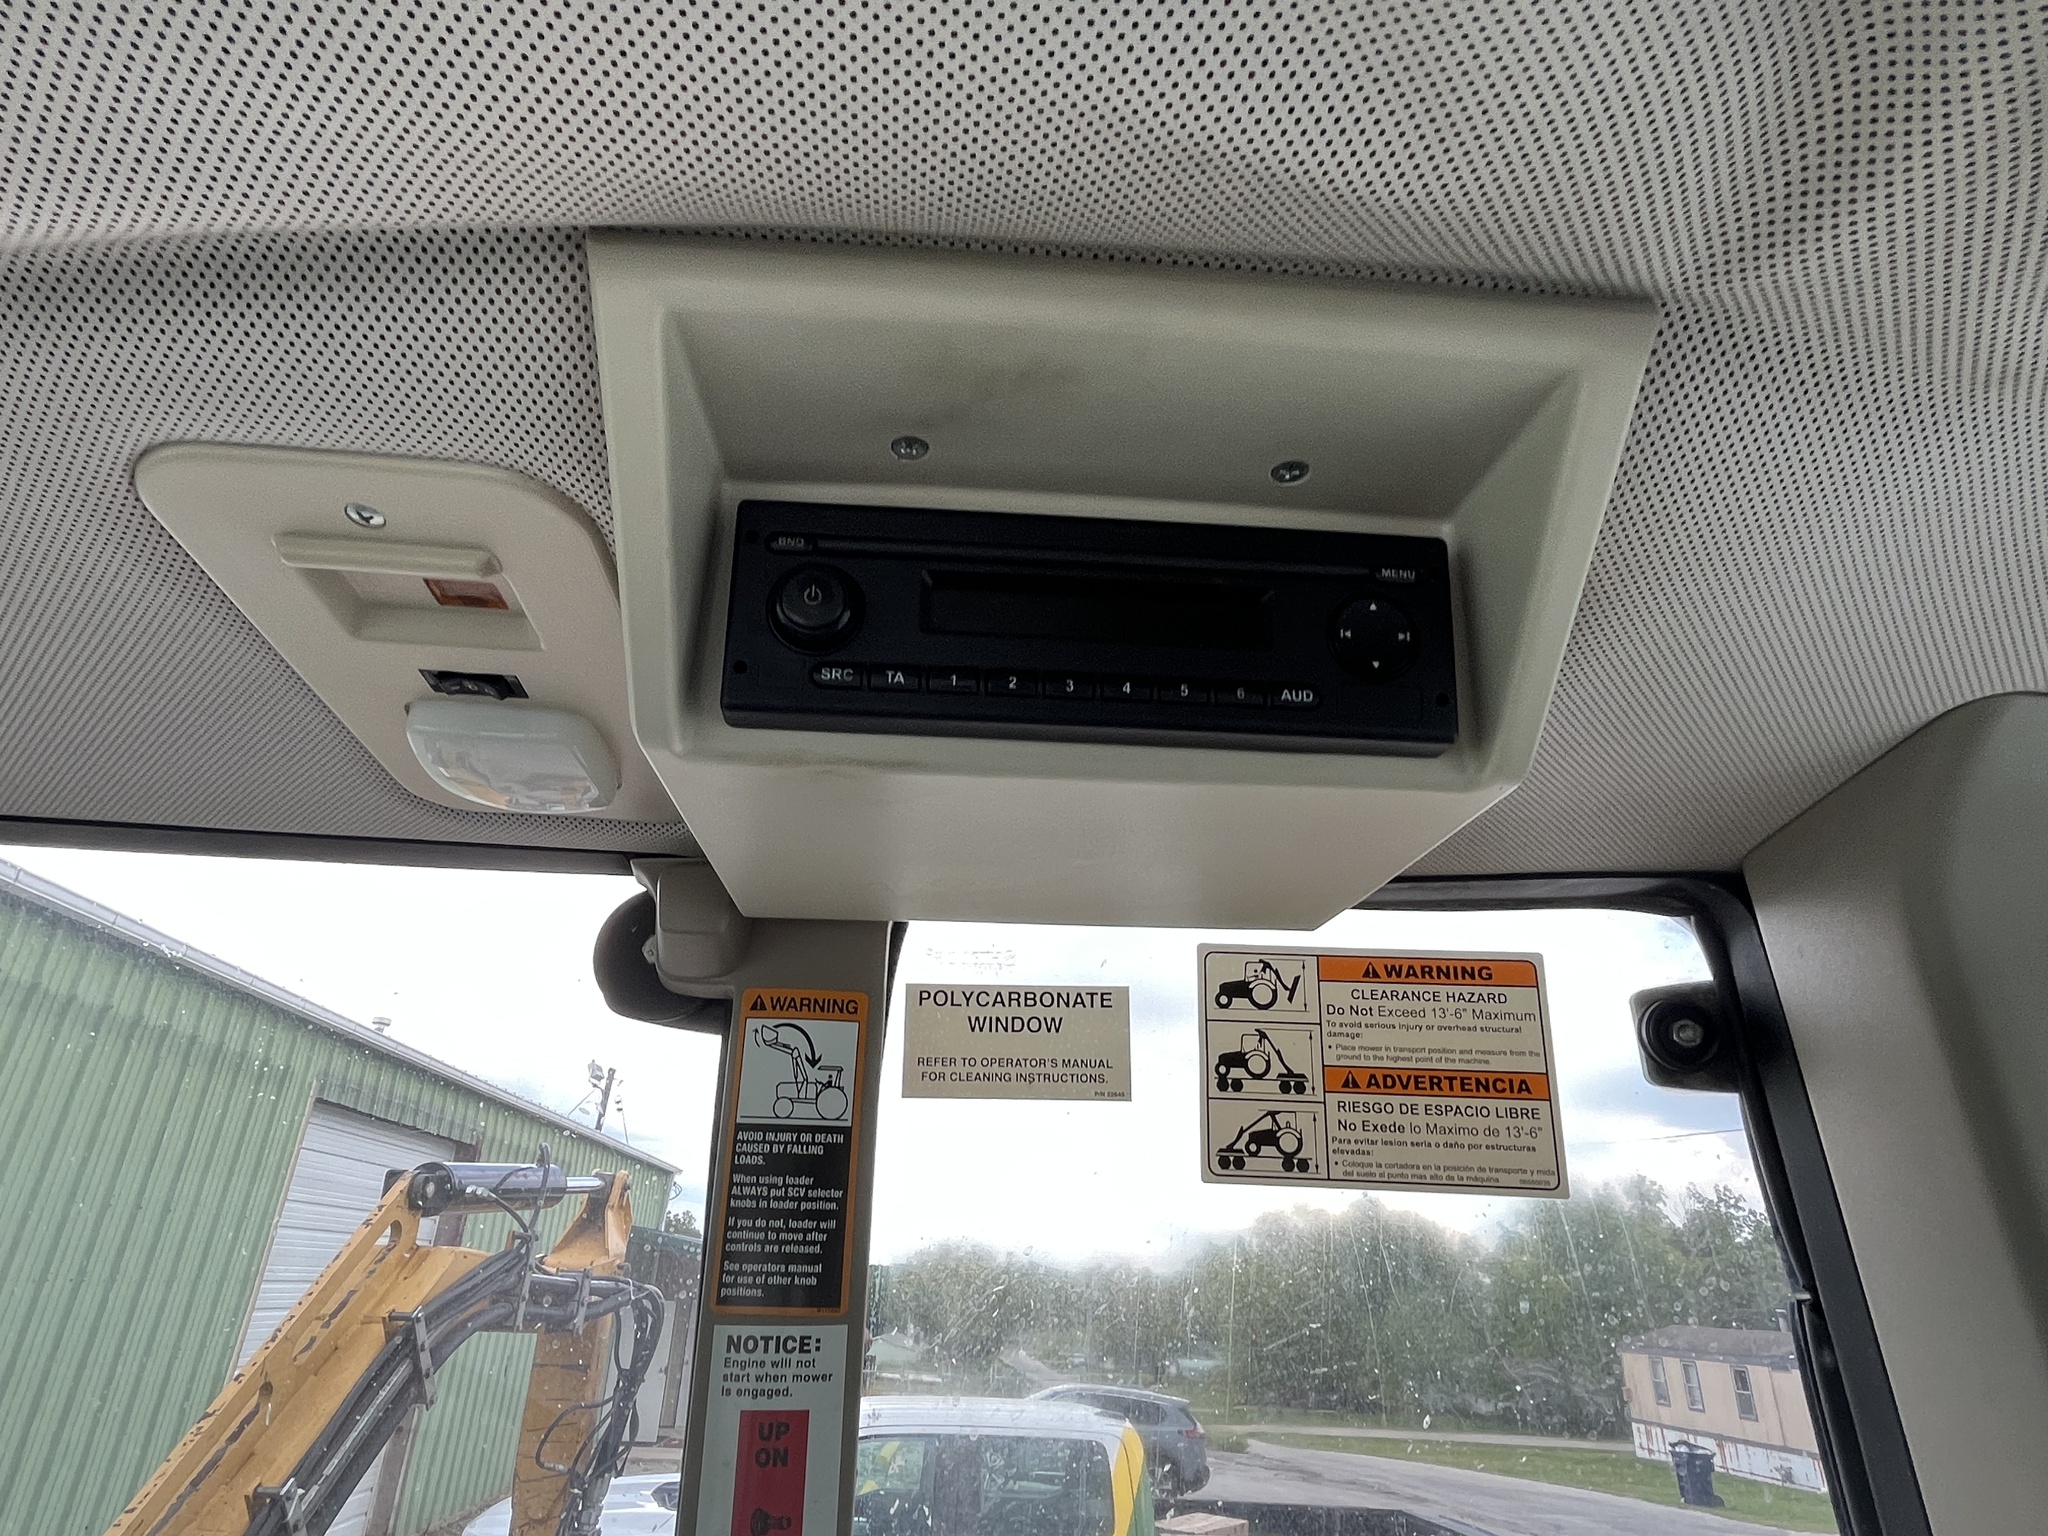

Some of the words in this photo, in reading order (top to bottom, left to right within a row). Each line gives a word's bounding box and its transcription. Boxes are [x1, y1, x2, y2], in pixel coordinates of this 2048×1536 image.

[778, 535, 805, 547] BND
[1381, 568, 1415, 580] MENU
[821, 667, 854, 681] SRC
[886, 670, 905, 685] TA
[951, 674, 957, 686] 1
[1008, 676, 1017, 690] 2
[1066, 679, 1074, 692] 3
[1122, 682, 1131, 694] 4
[1180, 684, 1189, 697] 5
[1236, 687, 1245, 700] 6
[1281, 689, 1314, 703] AUD
[1384, 964, 1493, 981] WARNING
[919, 990, 1113, 1009] POLYCARBONATE
[1351, 989, 1441, 1003] CLEARANCE
[1446, 991, 1508, 1004] HAZARD
[770, 996, 859, 1015] WARNING
[1326, 1004, 1345, 1016] Do
[1350, 1004, 1374, 1017] Not
[1378, 1006, 1426, 1019] Exceed
[1432, 1007, 1468, 1020] 13'-6"
[1472, 1008, 1536, 1022] Maximum
[968, 1016, 1063, 1033] WINDOW
[1398, 1023, 1422, 1032] injury
[1437, 1024, 1477, 1032] overhead
[1393, 1046, 1426, 1054] transport
[1428, 1047, 1456, 1055] position
[918, 1057, 957, 1067] REFER
[961, 1057, 977, 1068] TO
[980, 1057, 1058, 1068] OPERATOR'S
[1062, 1058, 1113, 1069] MANUAL
[1386, 1055, 1413, 1064] highest
[1415, 1056, 1433, 1064] point
[921, 1072, 946, 1082] FOR
[950, 1072, 1011, 1083] CLEANING
[1016, 1073, 1108, 1084] INSTRUCTIONS.
[1366, 1073, 1533, 1095] ADVERTENCIA
[1337, 1101, 1394, 1114] RIESGO
[1400, 1103, 1419, 1115] DE
[1425, 1104, 1491, 1118] ESPACIO
[1496, 1107, 1541, 1120] LIBRE
[1338, 1119, 1357, 1132] No
[1362, 1120, 1405, 1134] Exede
[1410, 1122, 1421, 1134] lo
[1426, 1123, 1479, 1137] Maximo
[1484, 1124, 1500, 1137] de
[1505, 1126, 1543, 1139] 13'-6"
[737, 1131, 763, 1141] AVOID
[766, 1132, 798, 1142] INJURY
[800, 1133, 812, 1143] OR
[814, 1133, 844, 1144] DEATH
[1332, 1136, 1351, 1144] Para
[1354, 1138, 1378, 1146] evitar
[1381, 1138, 1408, 1147] lesion
[1443, 1141, 1465, 1149] daño
[1468, 1143, 1482, 1151] por
[1485, 1143, 1536, 1152] estructuras
[735, 1143, 770, 1153] CAUSED
[772, 1144, 784, 1154] BY
[787, 1144, 824, 1155] FALLING
[735, 1154, 766, 1165] LOADS.
[733, 1173, 757, 1184] When
[758, 1174, 783, 1186] using
[786, 1175, 814, 1186] loader
[731, 1185, 768, 1197] ALWAYS
[770, 1187, 785, 1198] put
[787, 1187, 806, 1197] SCV
[808, 1188, 844, 1198] selector
[730, 1198, 756, 1208] knobs
[759, 1198, 767, 1208] in
[770, 1199, 798, 1209] loader
[800, 1200, 839, 1211] position.
[728, 1216, 735, 1226] If
[737, 1219, 753, 1229] you
[755, 1218, 766, 1227] do
[768, 1218, 786, 1230] not,
[789, 1219, 817, 1229] loader
[819, 1219, 836, 1229] will
[726, 1230, 765, 1240] continue
[768, 1231, 776, 1240] to
[779, 1232, 803, 1241] move
[806, 1231, 828, 1242] after
[725, 1242, 762, 1252] controls
[764, 1244, 779, 1253] are
[781, 1243, 822, 1254] released.
[723, 1260, 740, 1272] See
[742, 1262, 786, 1273] operators
[788, 1263, 822, 1273] manual
[722, 1273, 735, 1284] for
[737, 1275, 753, 1284] use
[755, 1274, 765, 1284] of
[768, 1274, 792, 1285] other
[794, 1275, 817, 1286] knob
[720, 1286, 765, 1298] positions.
[726, 1335, 822, 1354] NOTICE:
[724, 1357, 766, 1371] Engine
[770, 1358, 791, 1369] will
[796, 1358, 816, 1369] not
[722, 1372, 751, 1383] start
[755, 1372, 787, 1383] when
[792, 1373, 833, 1383] mower
[721, 1385, 731, 1397] is
[736, 1386, 793, 1400] engaged.
[758, 1421, 790, 1441] UP
[754, 1447, 789, 1468] ON
